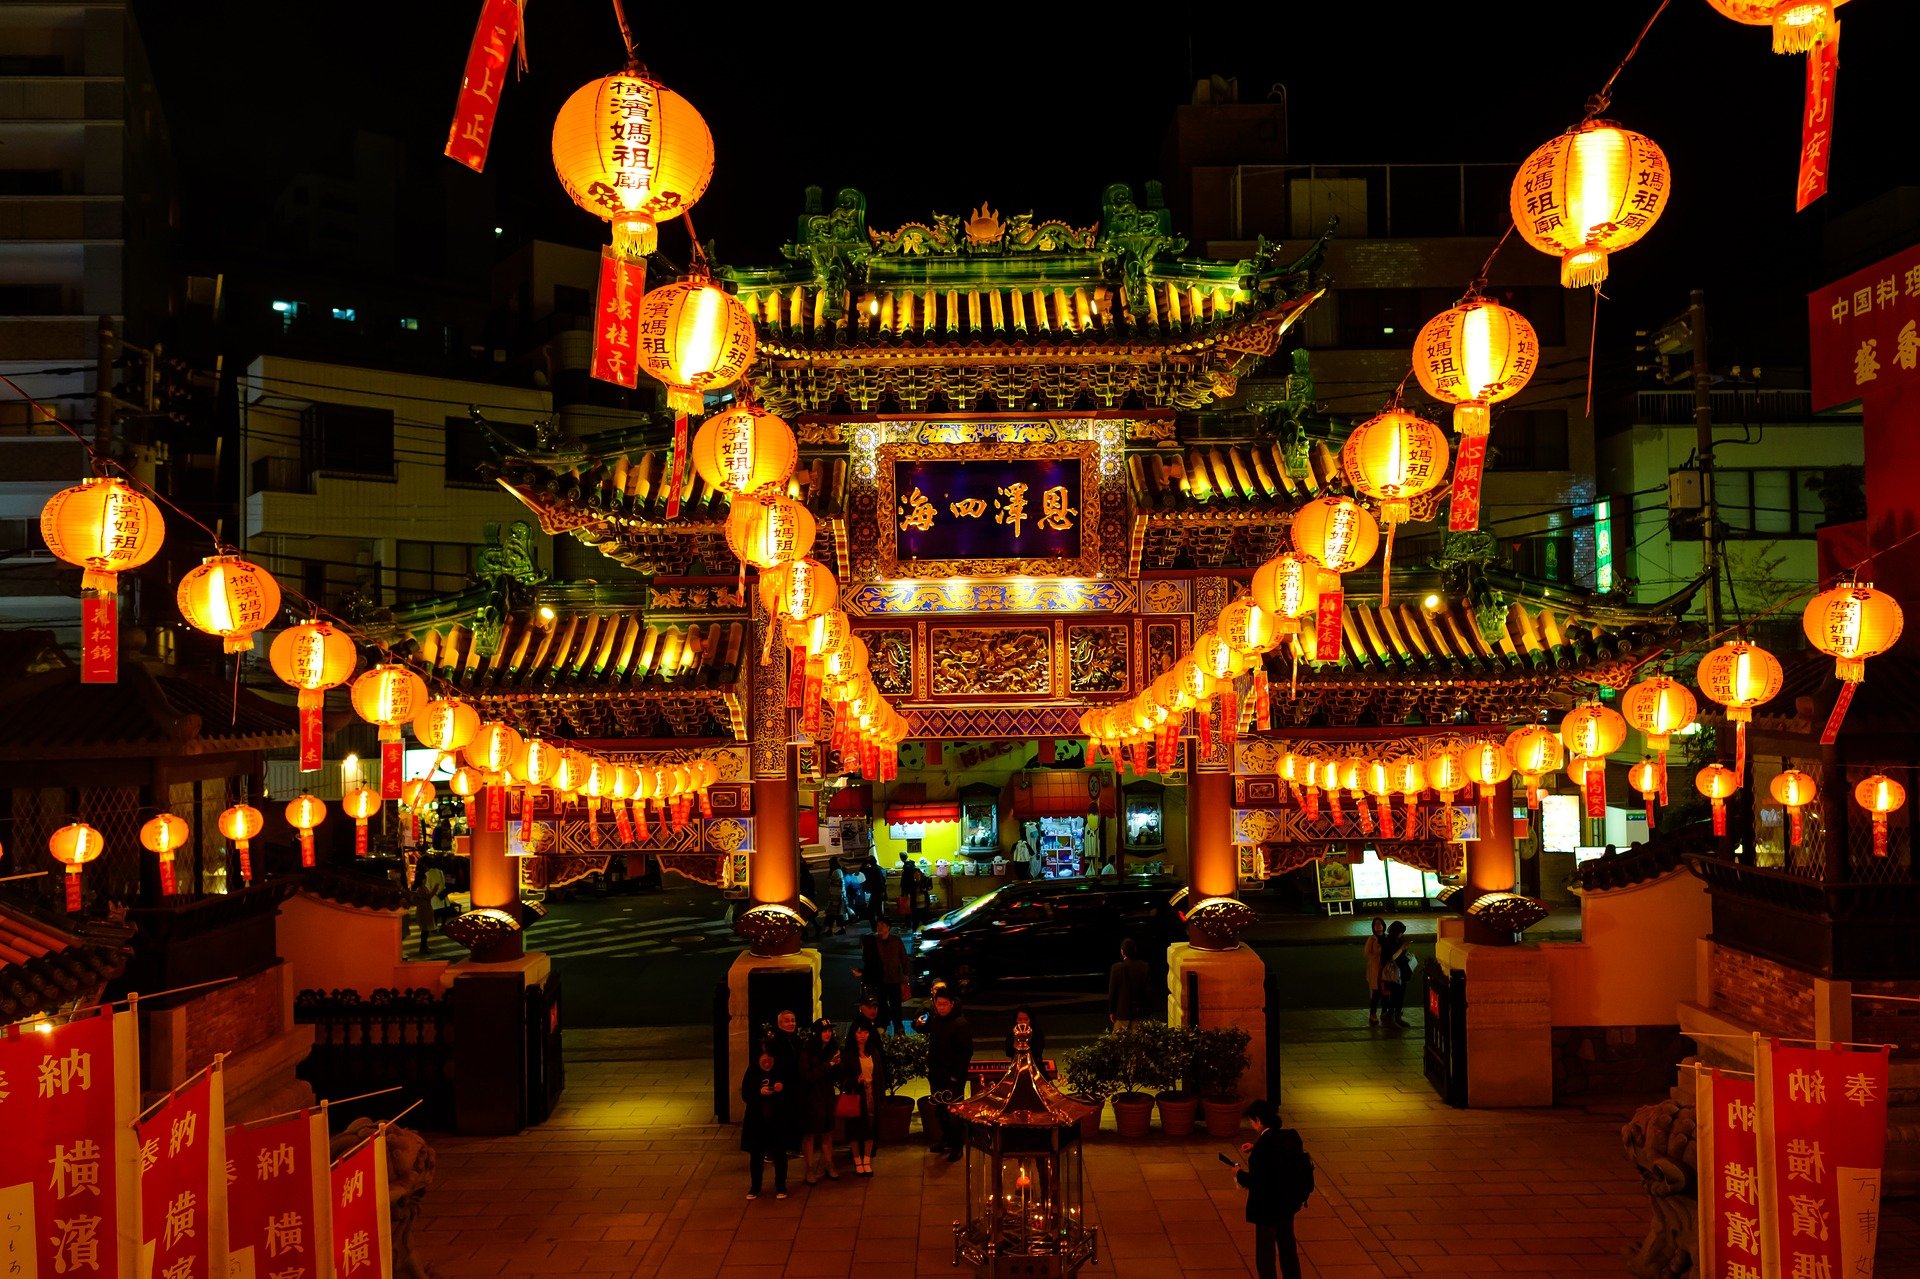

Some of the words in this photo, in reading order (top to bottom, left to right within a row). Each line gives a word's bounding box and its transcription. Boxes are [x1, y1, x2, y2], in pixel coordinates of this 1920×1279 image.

[610, 80, 655, 191] 横濱媽祖廟
[1523, 136, 1564, 235] 横濱媽祖廟
[1616, 134, 1665, 231] 横濱媽祖廟
[640, 290, 681, 371] 横濱媽祖廟
[1831, 263, 1920, 325] 中国料理
[1426, 312, 1462, 389] 横濱媽祖廟
[1400, 422, 1434, 488] 横濱媽祖廟
[1451, 444, 1483, 528] 心願成就
[48, 1139, 103, 1275] 横濱
